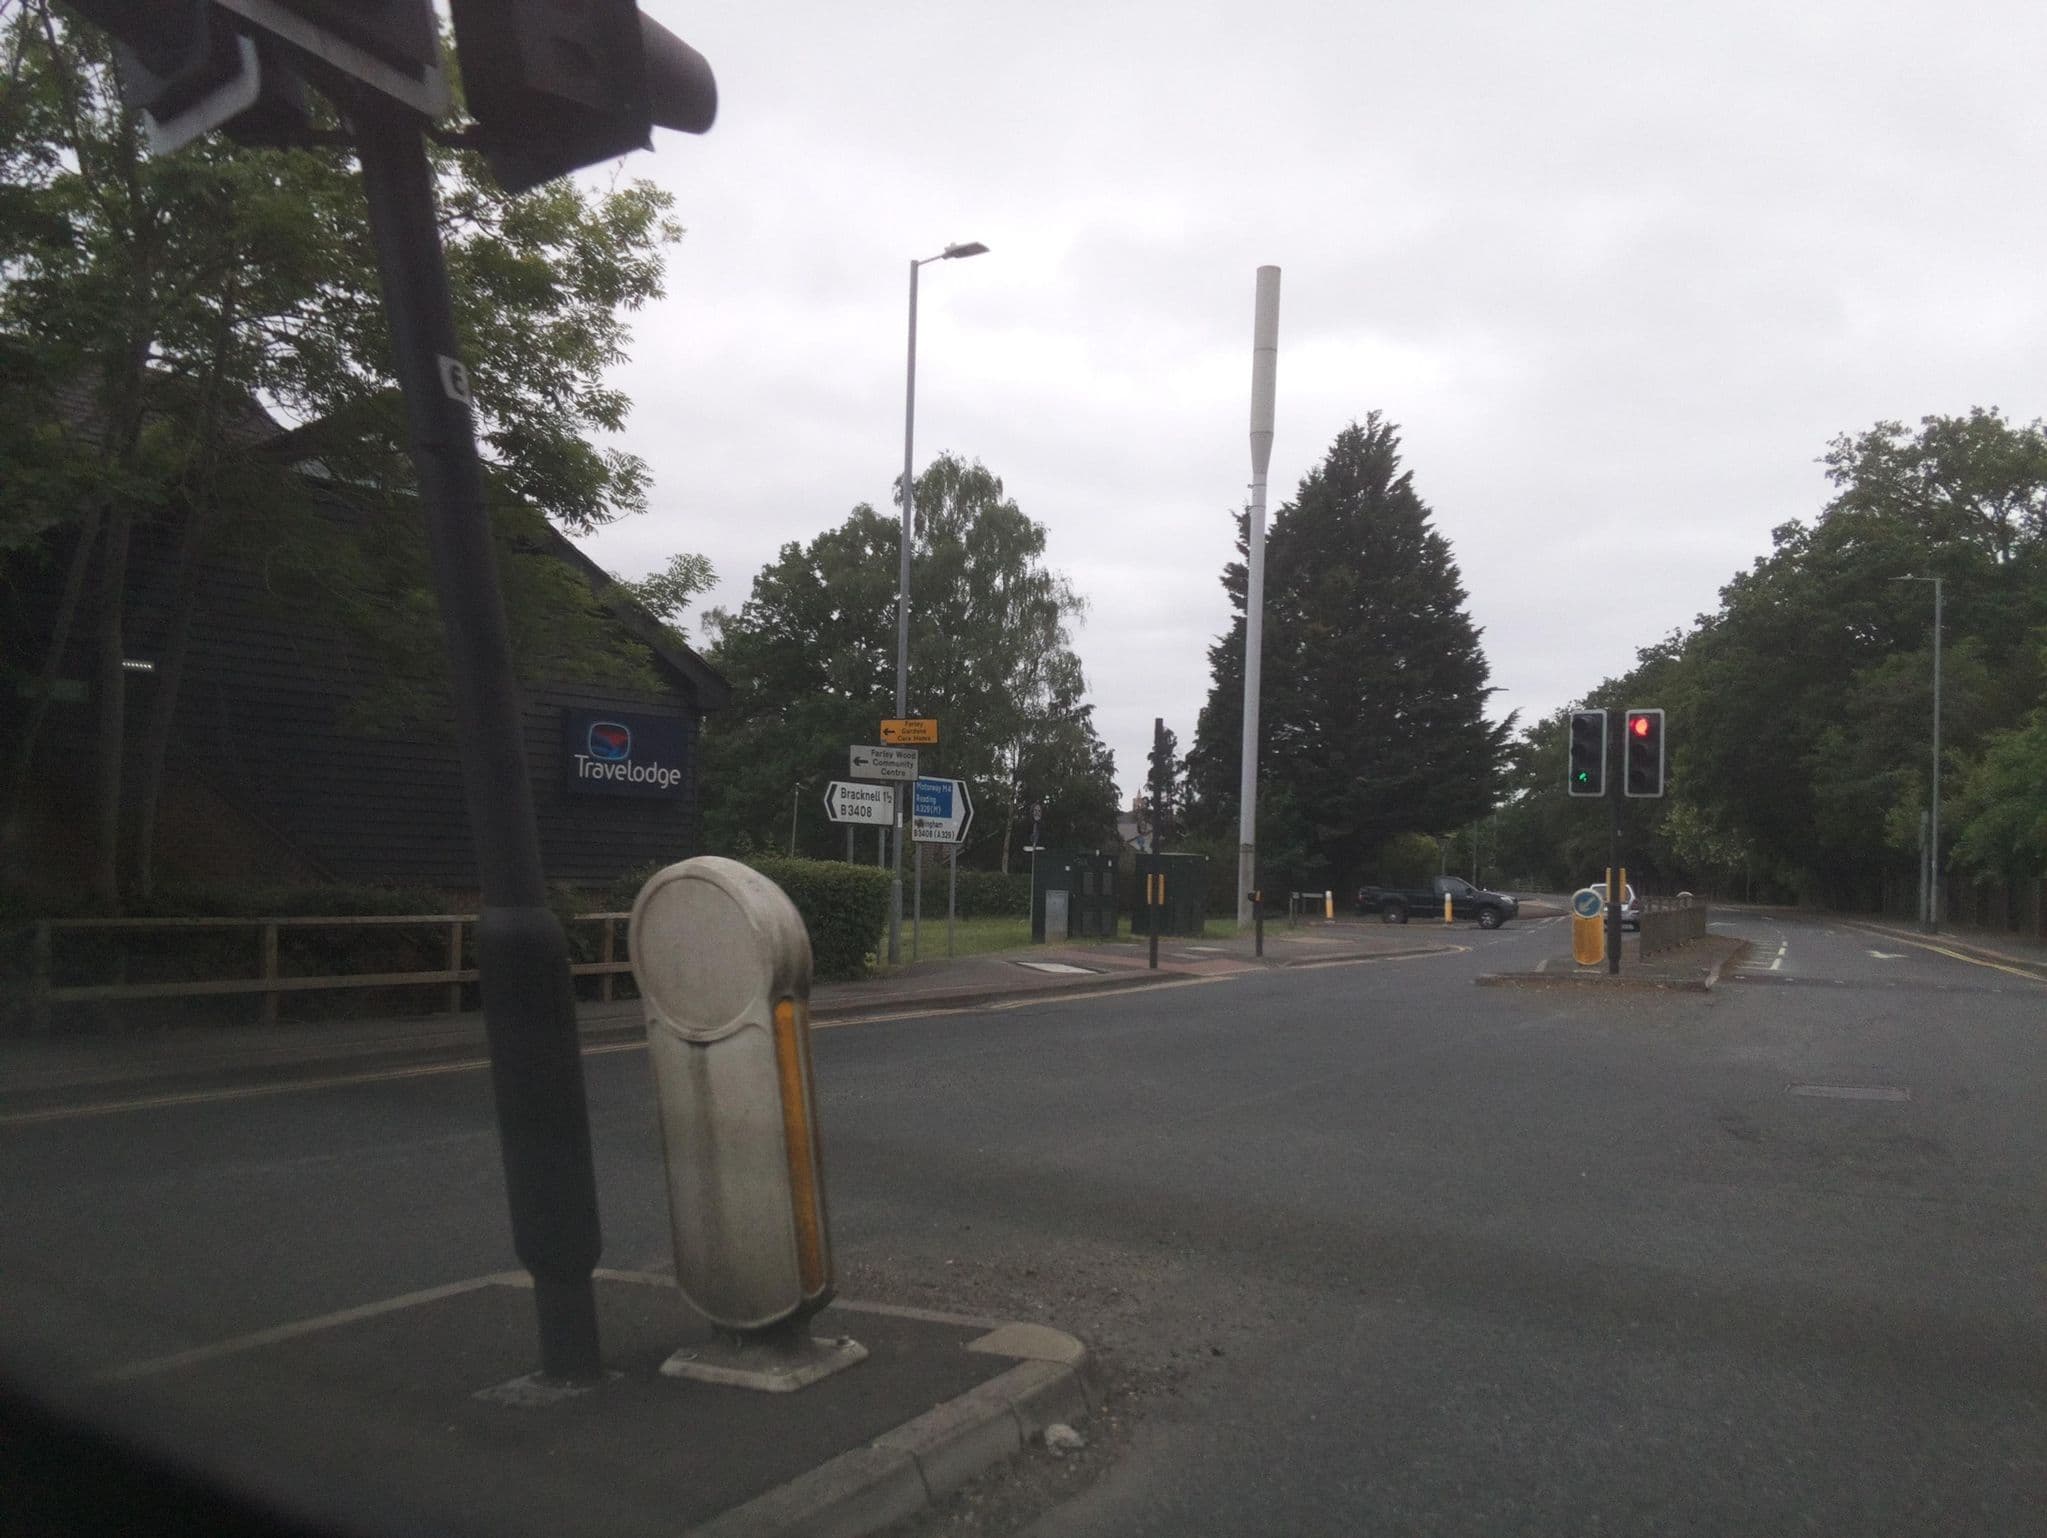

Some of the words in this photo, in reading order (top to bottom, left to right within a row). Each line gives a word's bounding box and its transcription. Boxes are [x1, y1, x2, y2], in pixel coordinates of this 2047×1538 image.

[871, 750, 893, 759] Farley
[896, 751, 916, 759] Wood
[873, 758, 914, 769] Community
[574, 754, 681, 789] Travelodge
[881, 768, 906, 777] Centre
[841, 787, 880, 802] Bracknell
